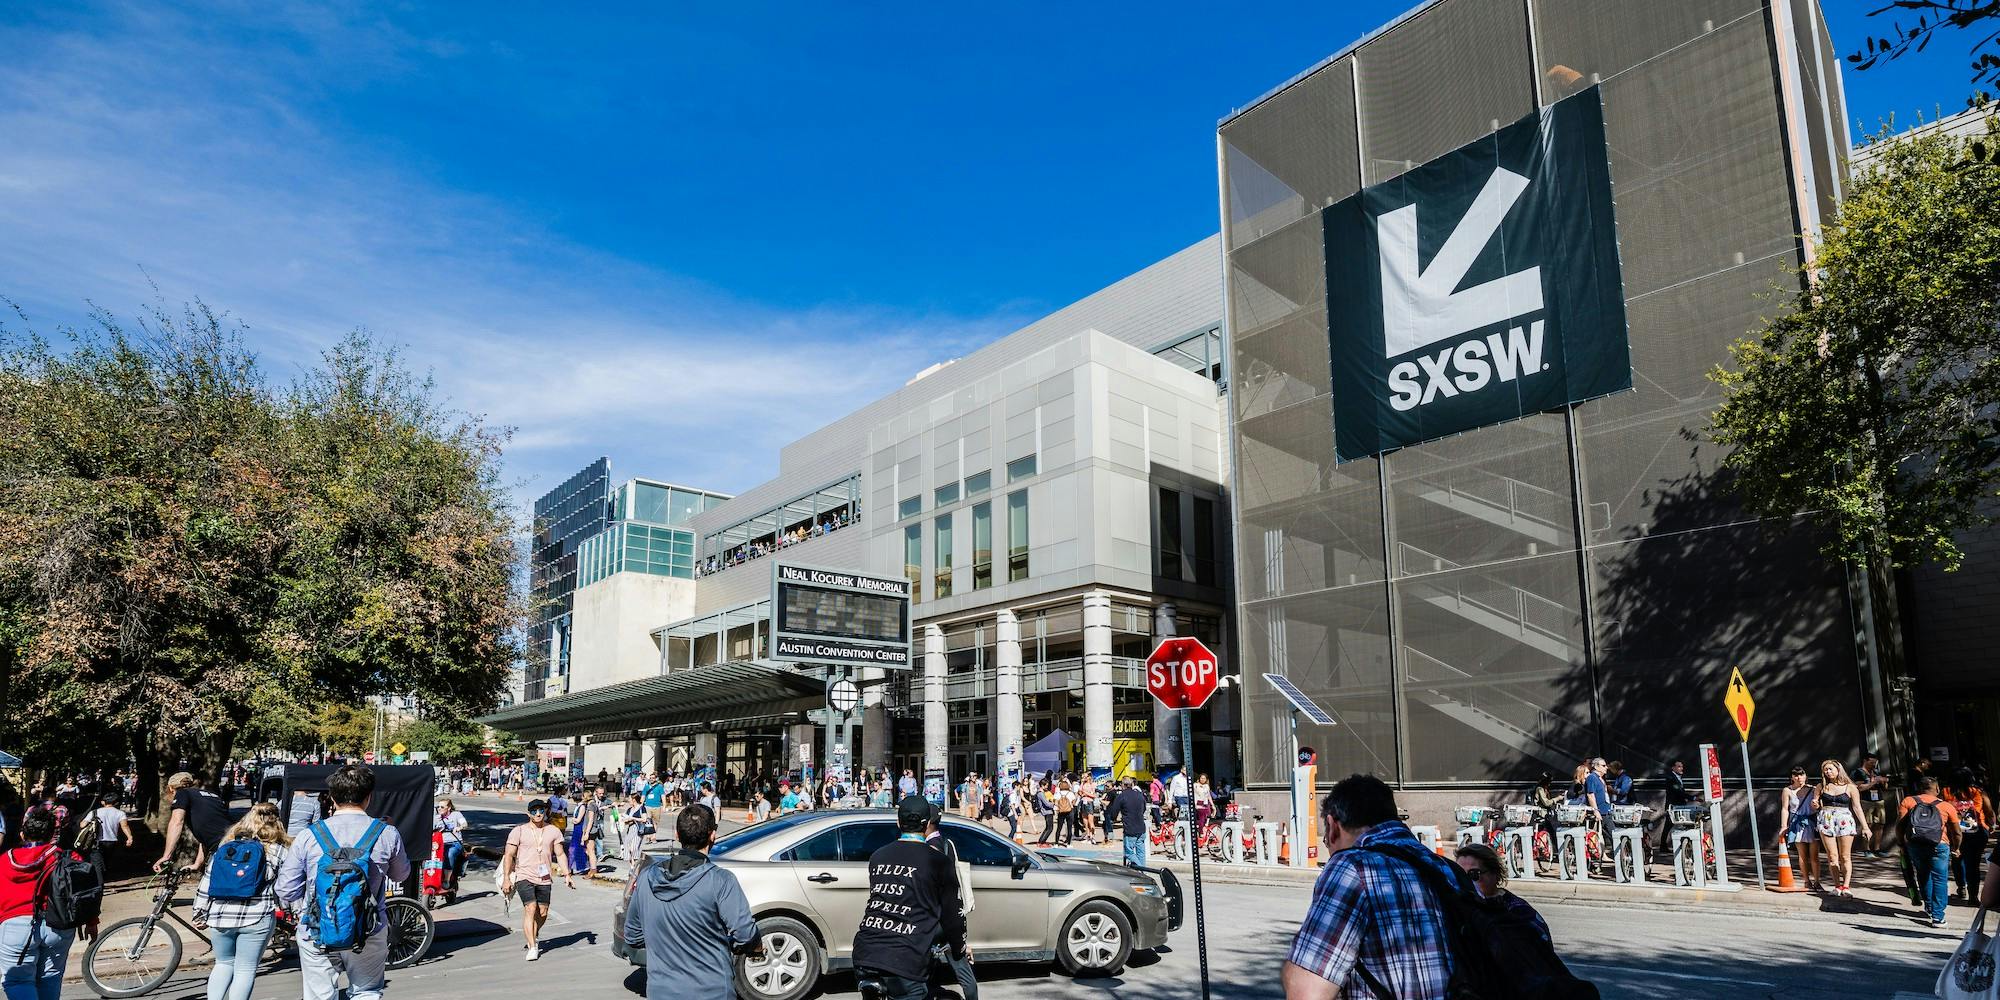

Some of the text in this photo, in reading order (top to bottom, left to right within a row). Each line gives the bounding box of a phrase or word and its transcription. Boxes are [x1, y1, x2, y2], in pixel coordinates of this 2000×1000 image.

[783, 567, 904, 593] NEAL KOCUREK MEMORIAL
[779, 642, 906, 662] AUSTIN CONVENTION CENTER
[1151, 659, 1214, 688] STOP
[1124, 719, 1148, 733] CHEESE
